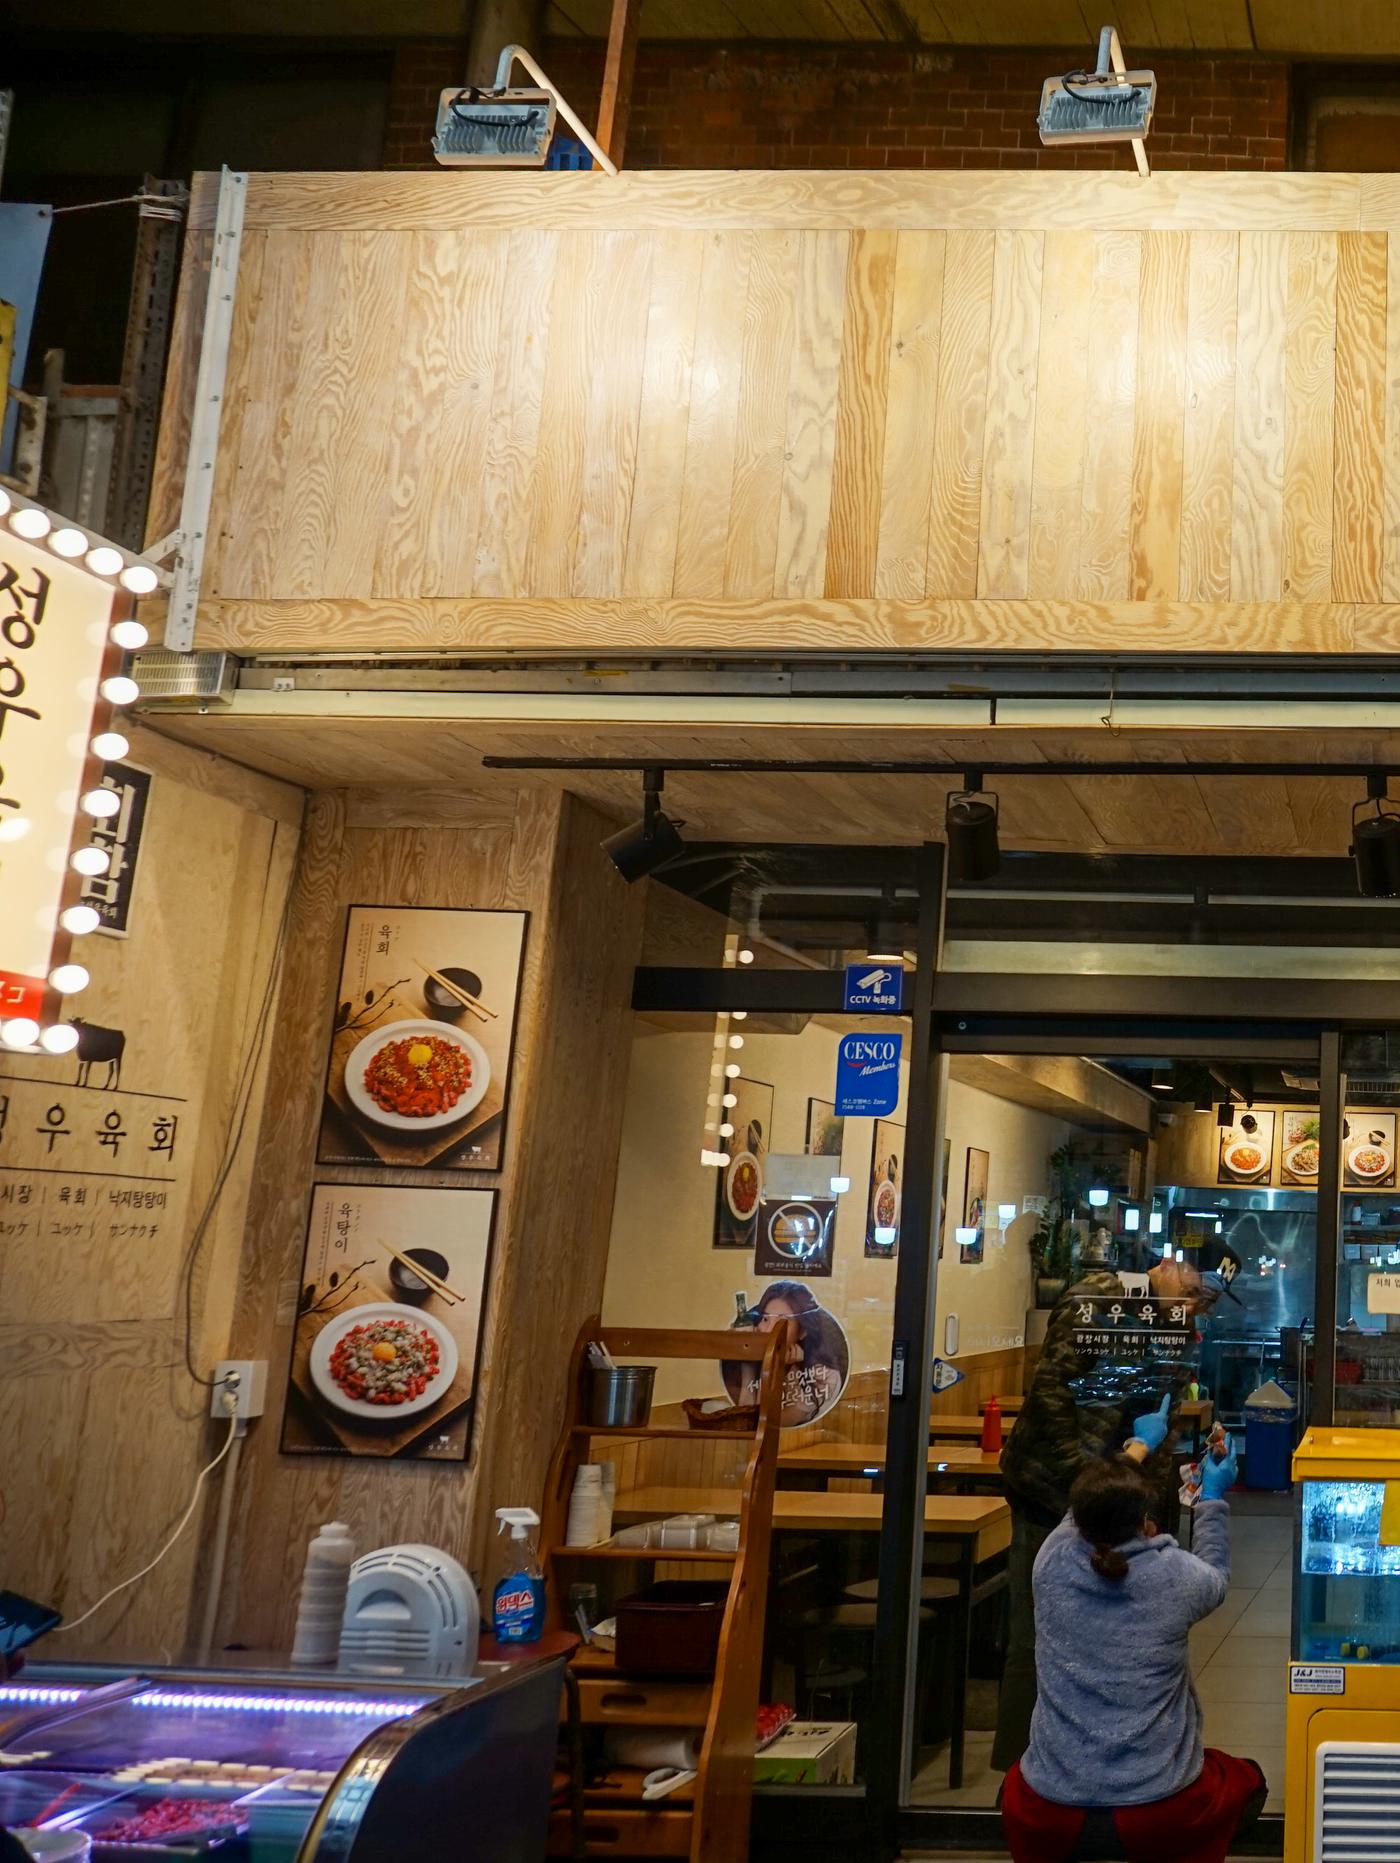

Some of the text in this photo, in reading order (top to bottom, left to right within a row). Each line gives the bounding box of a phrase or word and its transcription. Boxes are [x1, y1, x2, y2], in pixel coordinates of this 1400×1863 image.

[376, 925, 392, 956] 육회
[849, 995, 871, 1004] CCTV
[844, 1041, 896, 1060] CESCO
[858, 1061, 897, 1077] Members
[59, 1186, 87, 1206] 육회
[109, 1190, 168, 1210] 낙지탕탕이
[1076, 1302, 1186, 1326] 성우육회
[1076, 1334, 1109, 1344] 광장시장
[1123, 1335, 1139, 1344] 육회
